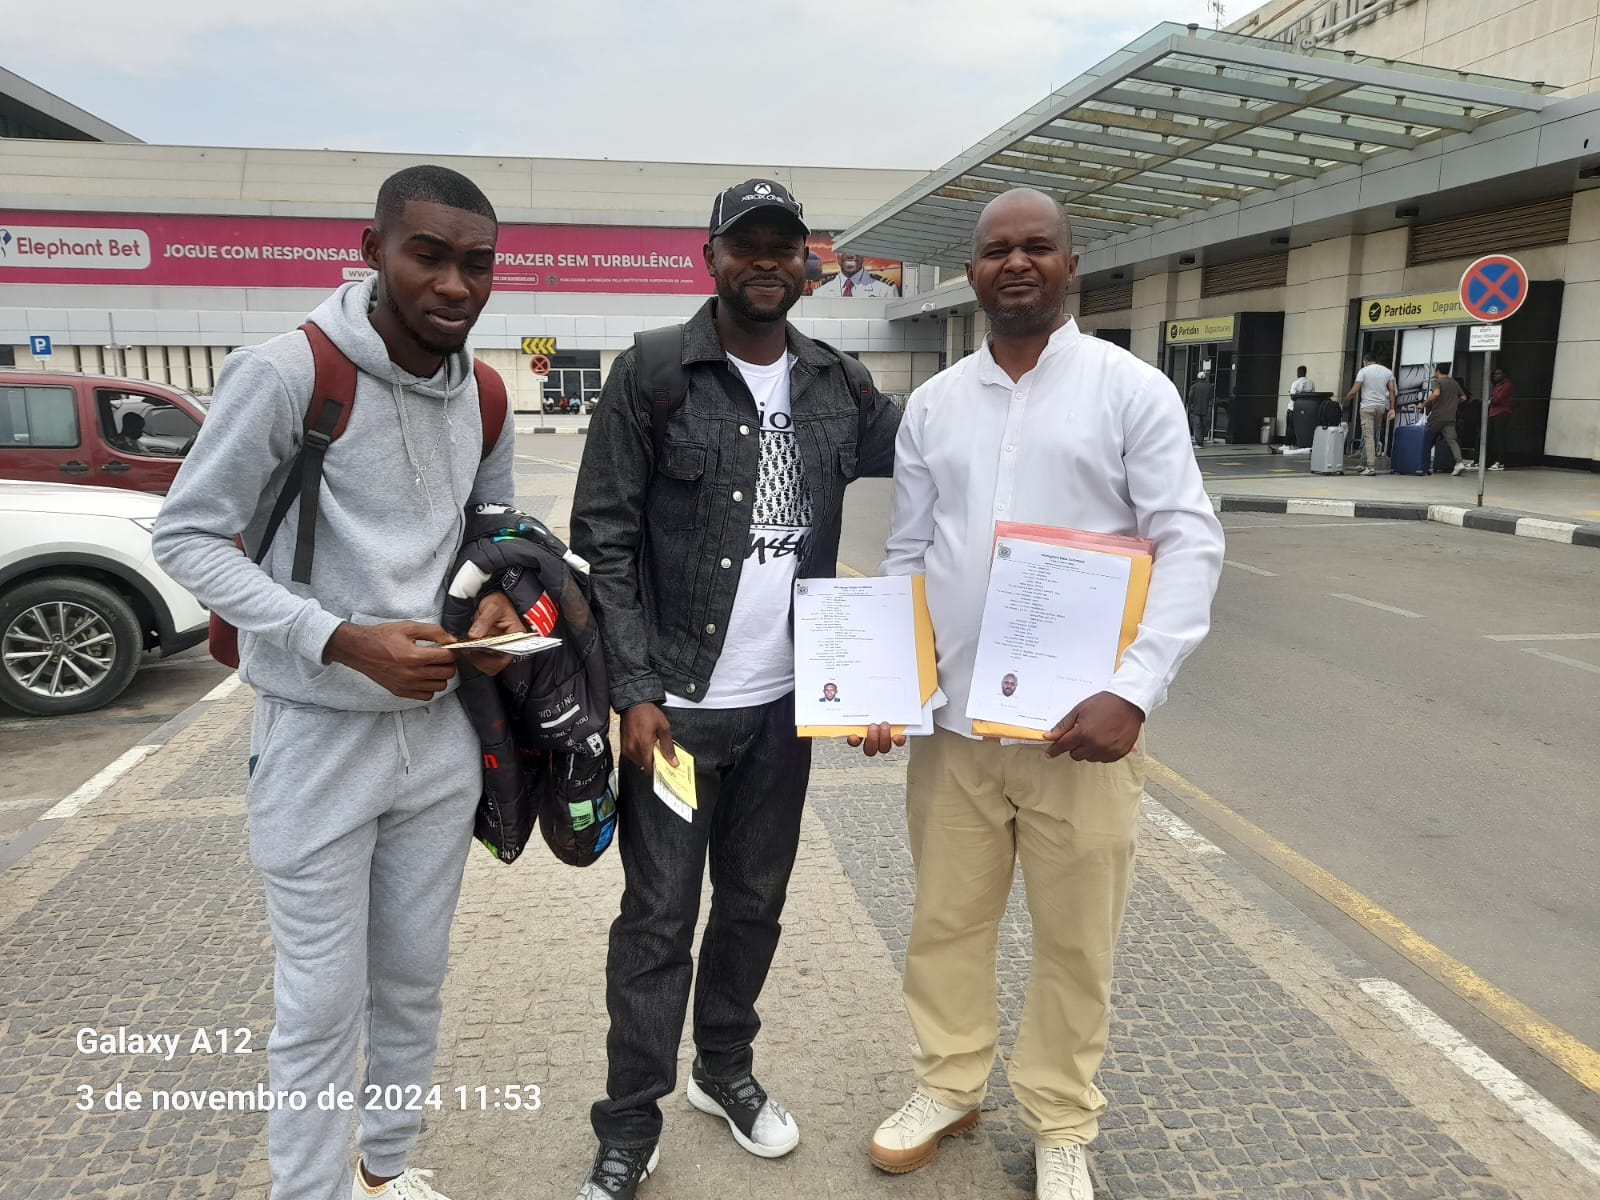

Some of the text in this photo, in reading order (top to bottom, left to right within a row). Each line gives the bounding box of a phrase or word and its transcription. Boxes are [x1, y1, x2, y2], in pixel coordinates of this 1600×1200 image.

[16, 237, 141, 259] Elephant Bet
[163, 244, 364, 262] JOGUE COM RESPONSABI
[494, 251, 694, 268] PRAZER SEM TURBULÊNCIA
[1384, 301, 1463, 317] Partidas Depart
[35, 338, 46, 352] P
